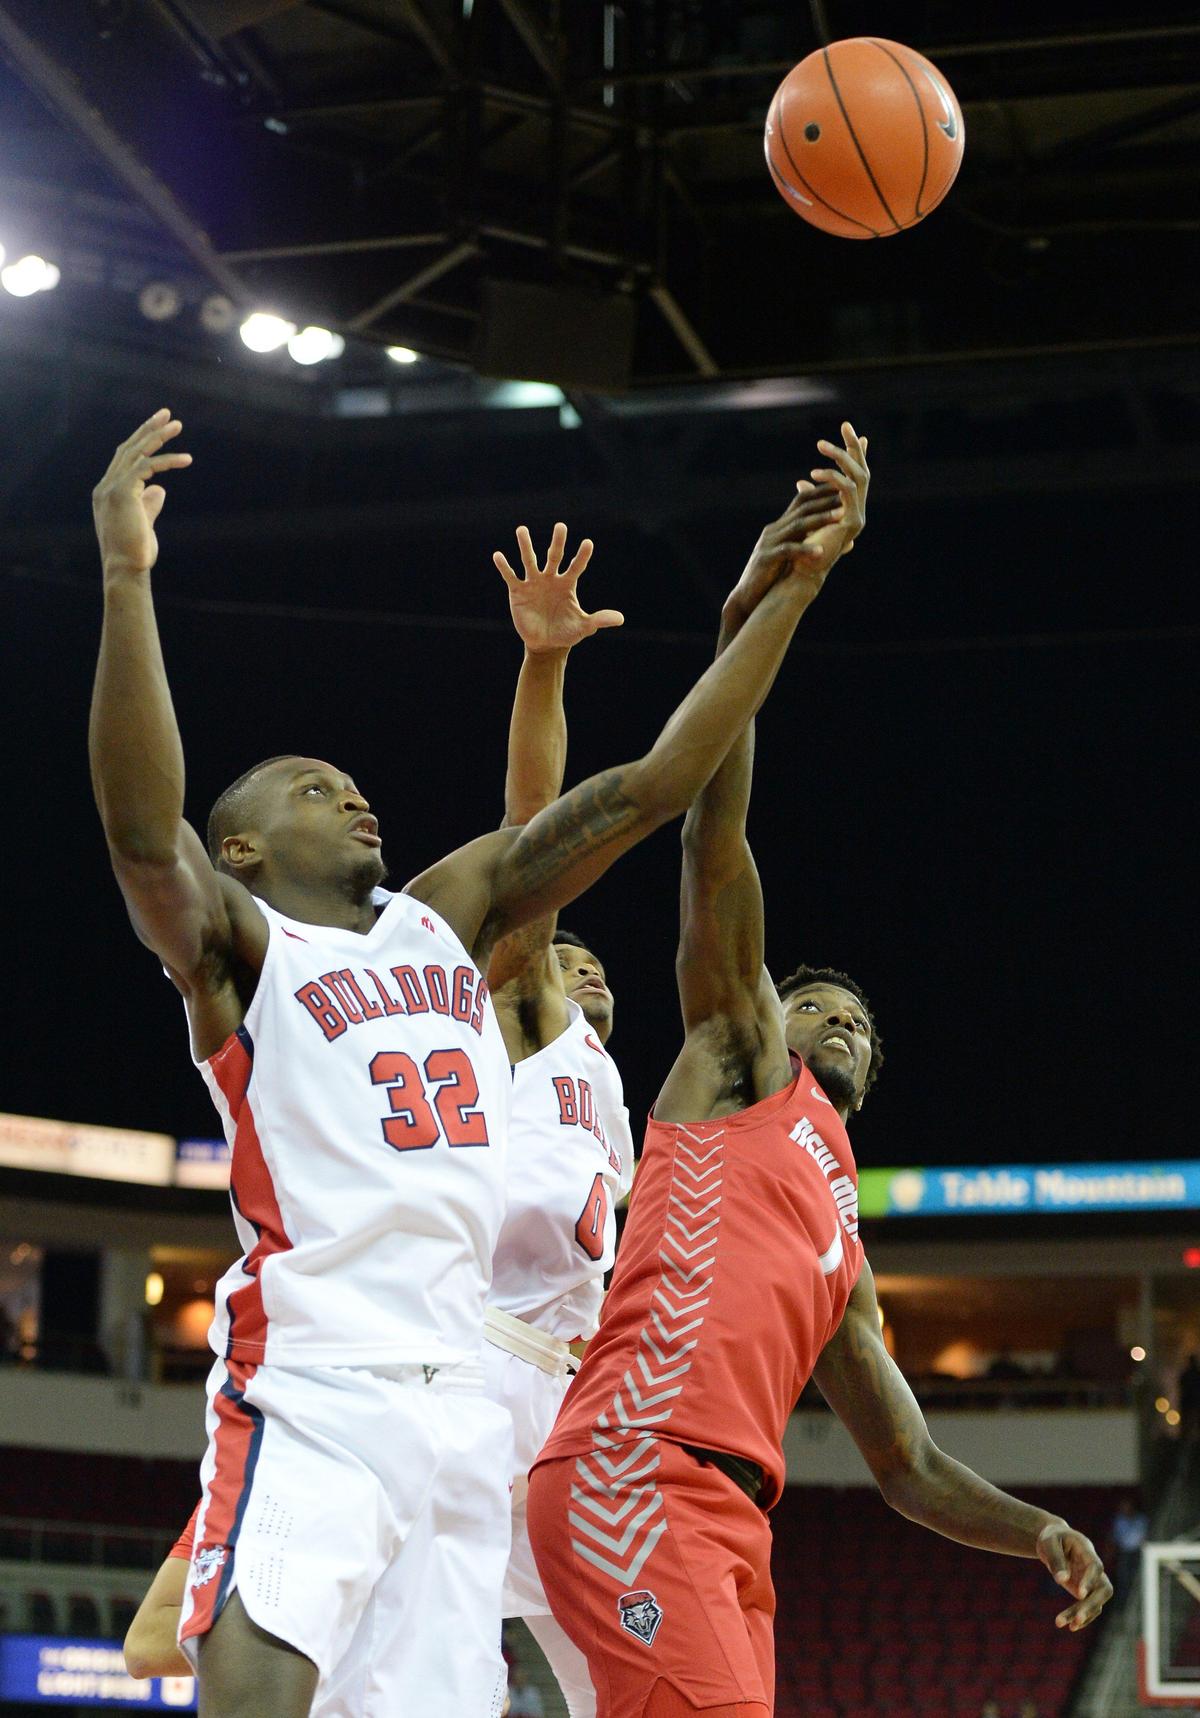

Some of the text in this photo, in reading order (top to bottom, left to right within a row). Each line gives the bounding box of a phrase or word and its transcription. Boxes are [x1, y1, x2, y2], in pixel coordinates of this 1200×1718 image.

[294, 964, 489, 1043] BULLDOGS
[368, 1048, 490, 1152] 32
[575, 1172, 608, 1261] 0
[940, 1167, 1187, 1207] Table Mountain
